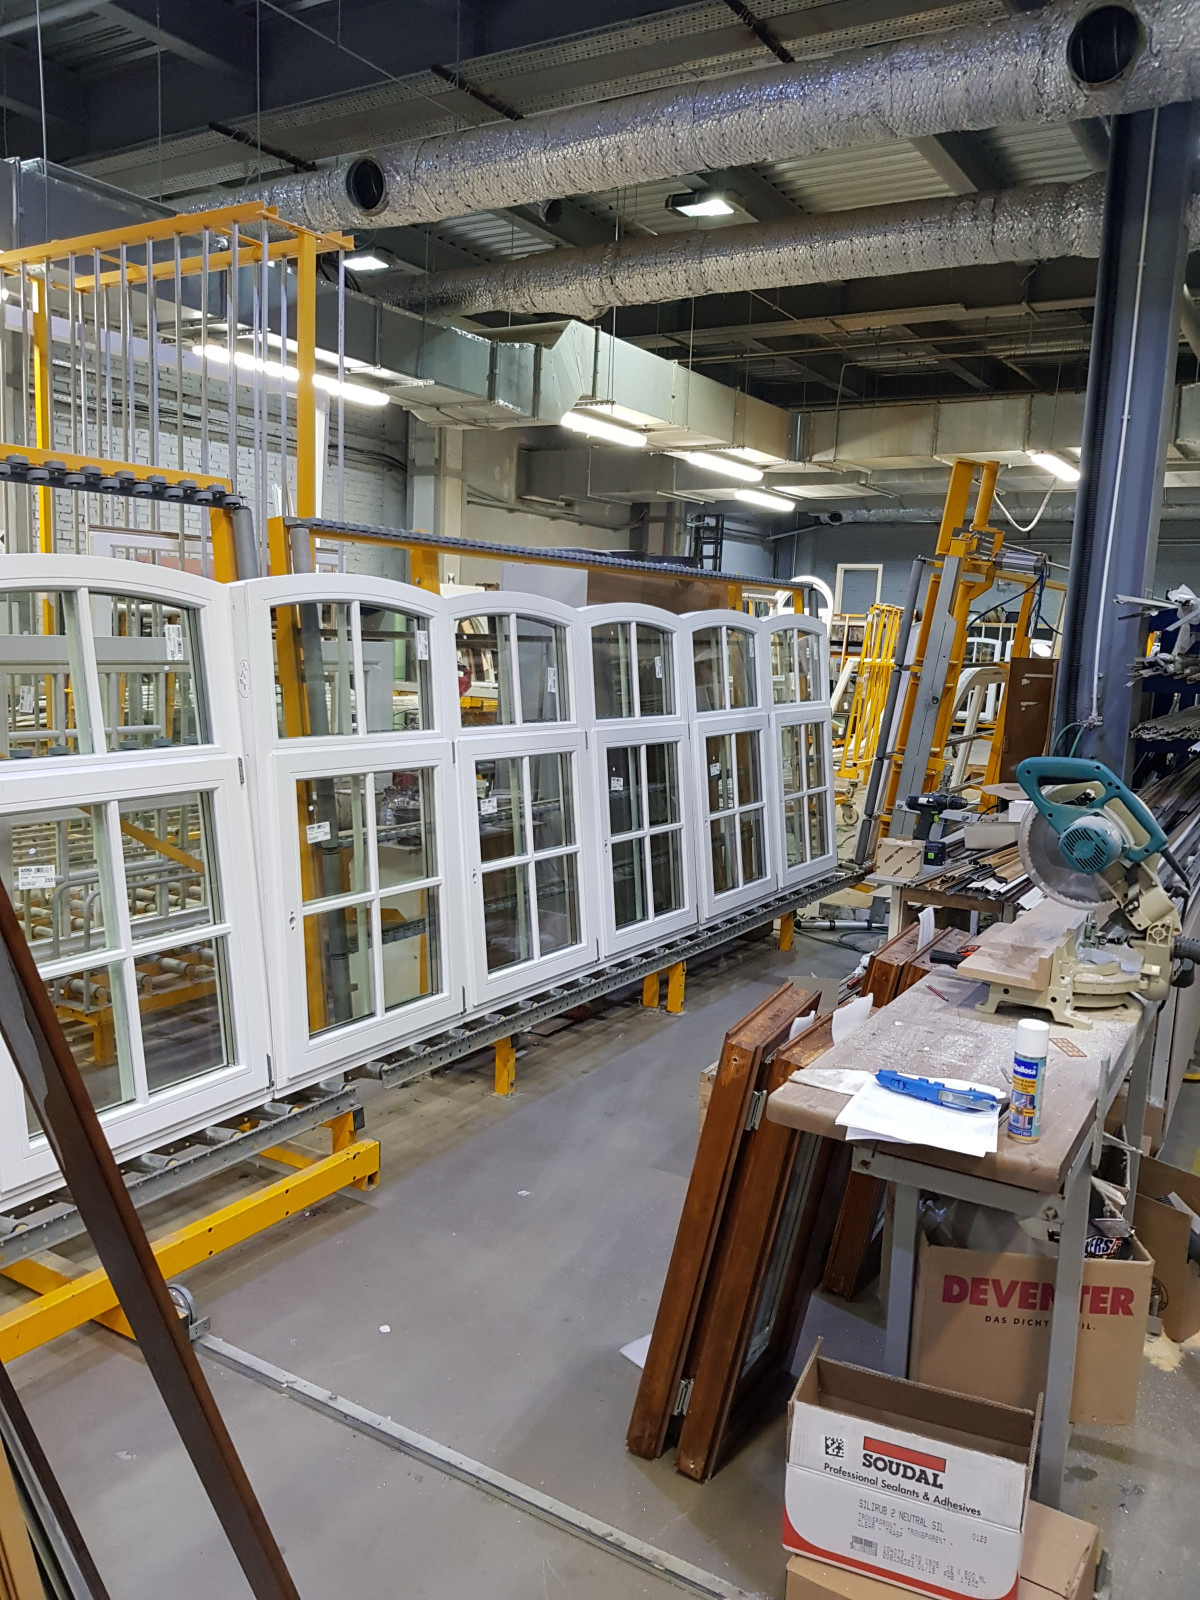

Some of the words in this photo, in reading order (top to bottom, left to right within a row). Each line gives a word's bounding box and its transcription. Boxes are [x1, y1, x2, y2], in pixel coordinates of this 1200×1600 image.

[1014, 1062, 1036, 1075] Quilosa
[985, 1316, 1007, 1324] DAS
[862, 1452, 944, 1490] SOUDAL
[824, 1462, 878, 1486] Professional
[881, 1480, 920, 1500] Sealants
[922, 1492, 930, 1501] &
[933, 1495, 981, 1516] Adhesives
[859, 1498, 888, 1516] SILIRUB
[891, 1508, 896, 1518] 2
[899, 1510, 928, 1528] NEUTRAL
